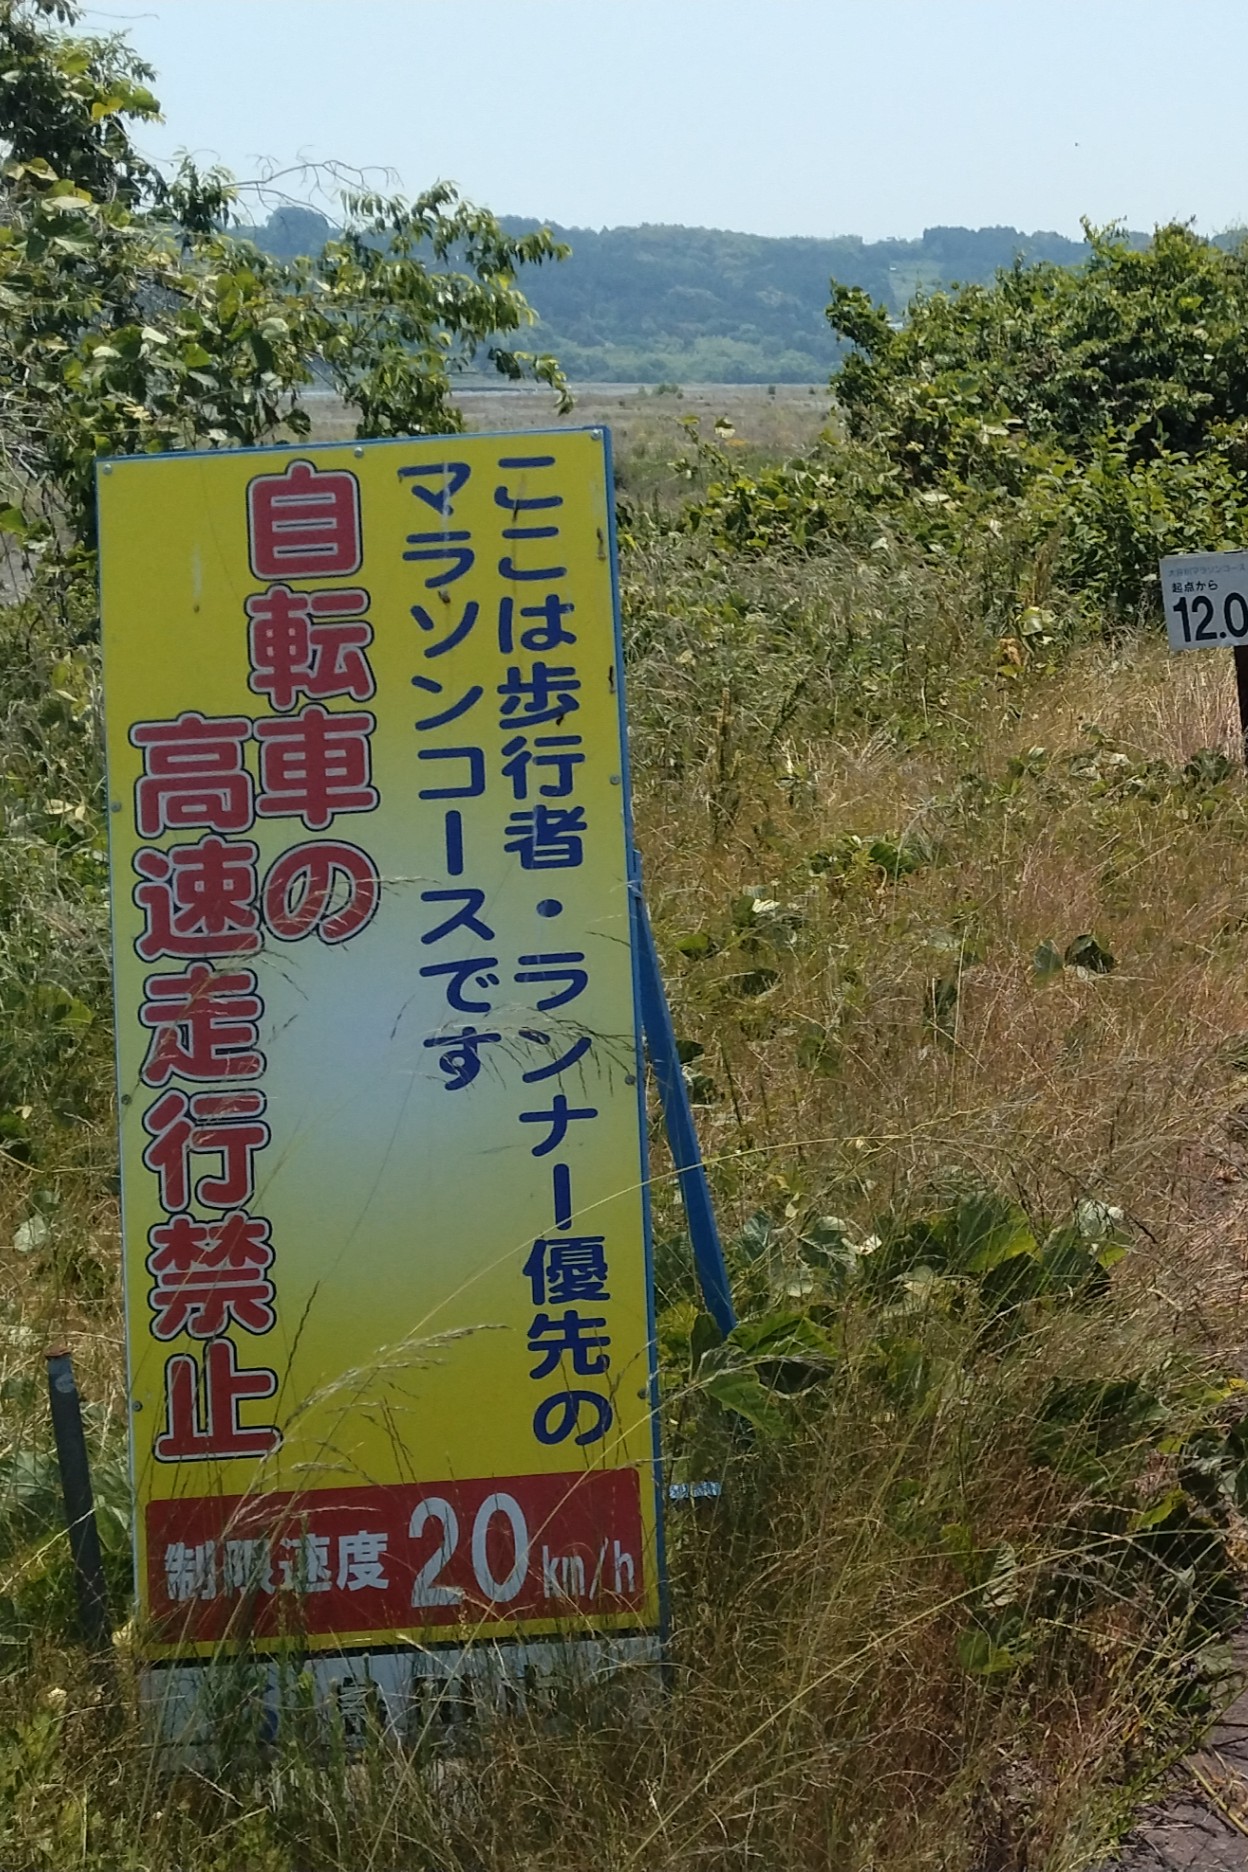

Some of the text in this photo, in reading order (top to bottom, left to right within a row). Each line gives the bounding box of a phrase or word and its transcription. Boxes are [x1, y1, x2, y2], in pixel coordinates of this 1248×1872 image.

[245, 459, 381, 945] 自転車の
[397, 461, 501, 1091] マラソンコースです
[1172, 580, 1218, 594] 起点から
[128, 709, 284, 1462] 高速走行禁止
[494, 456, 614, 1446] ここは歩行者・ランナー優先の
